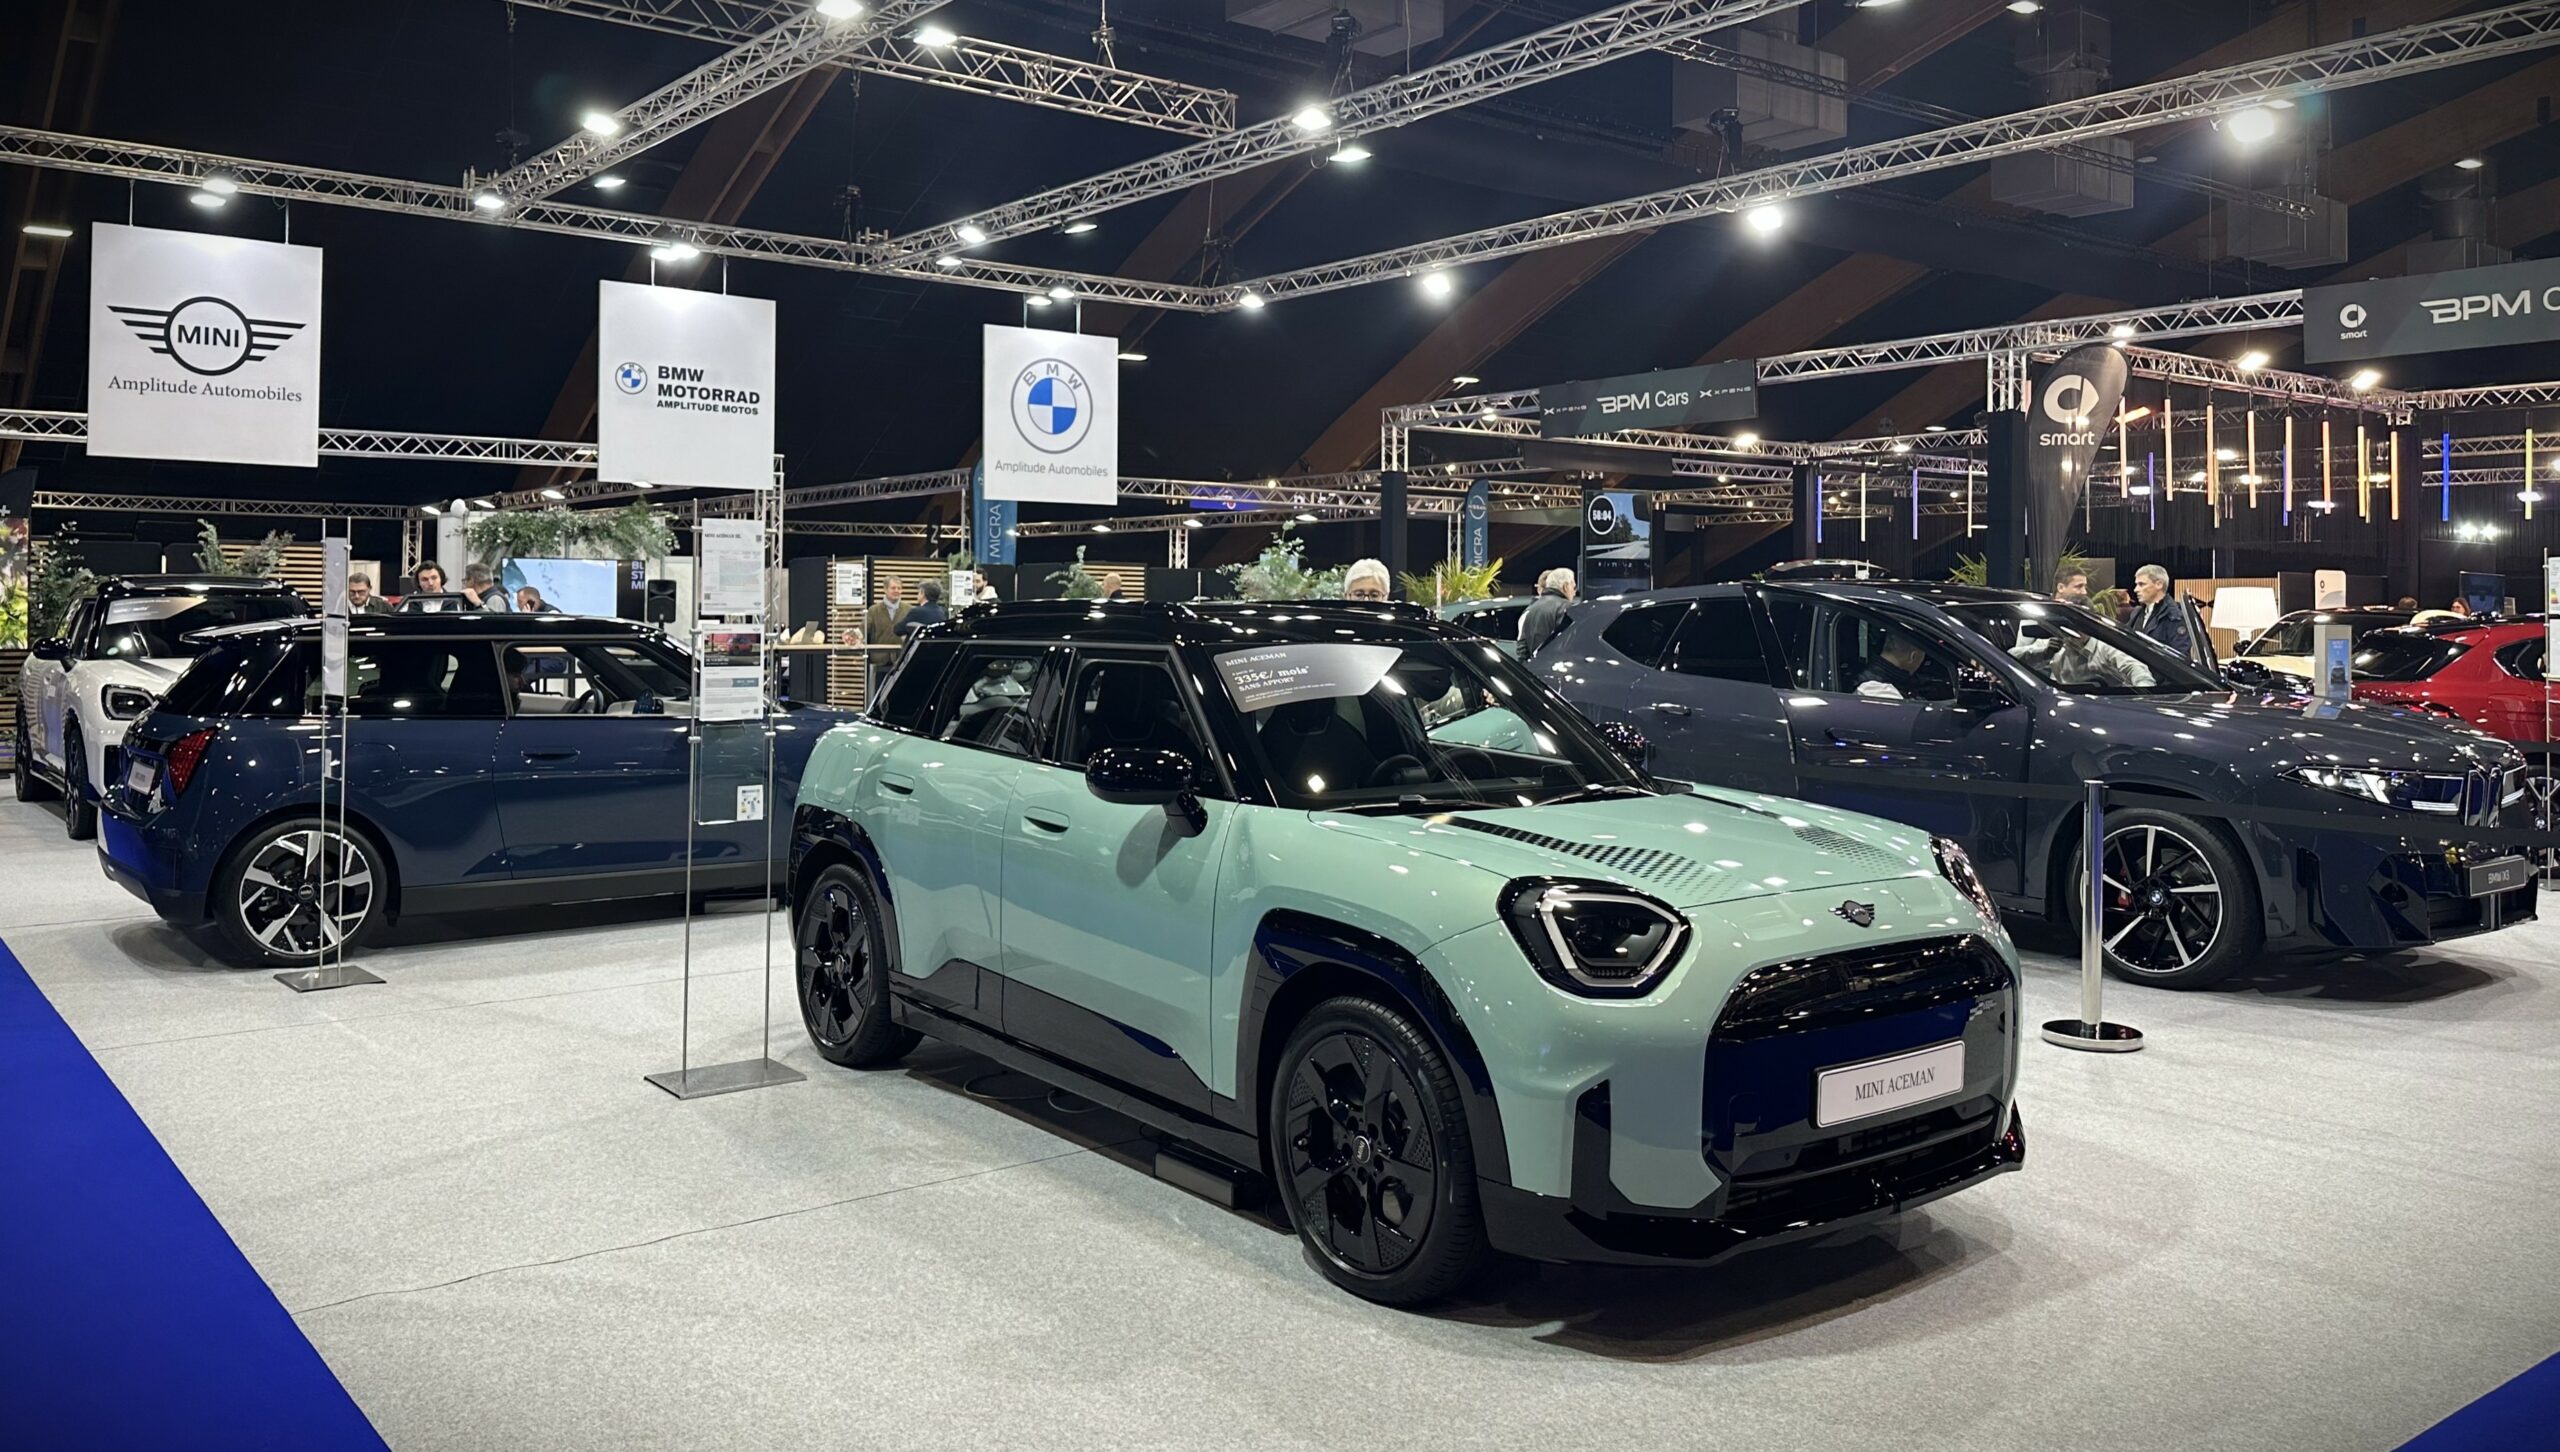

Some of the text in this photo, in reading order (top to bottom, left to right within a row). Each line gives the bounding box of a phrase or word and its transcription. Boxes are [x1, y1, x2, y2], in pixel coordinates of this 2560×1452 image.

[2419, 289, 2531, 324] BPM
[177, 324, 240, 348] MINI
[2340, 329, 2368, 340] smart
[658, 365, 704, 382] BMW
[1022, 363, 1083, 391] BMW
[108, 375, 302, 402] Amplitude Automobiles
[658, 384, 760, 404] MOTORRAD
[657, 400, 759, 415] AMPLITUDE MOTOS
[1596, 390, 1689, 414] BPM Cars
[2039, 431, 2095, 446] smart
[995, 460, 1108, 477] Amplitude Automobiles
[989, 503, 1002, 558] MICRA
[1225, 652, 1287, 667] MINI ACEMAN
[1238, 676, 1294, 692] SANS APPORT
[1855, 1066, 1936, 1101] MINI ACEMAN
